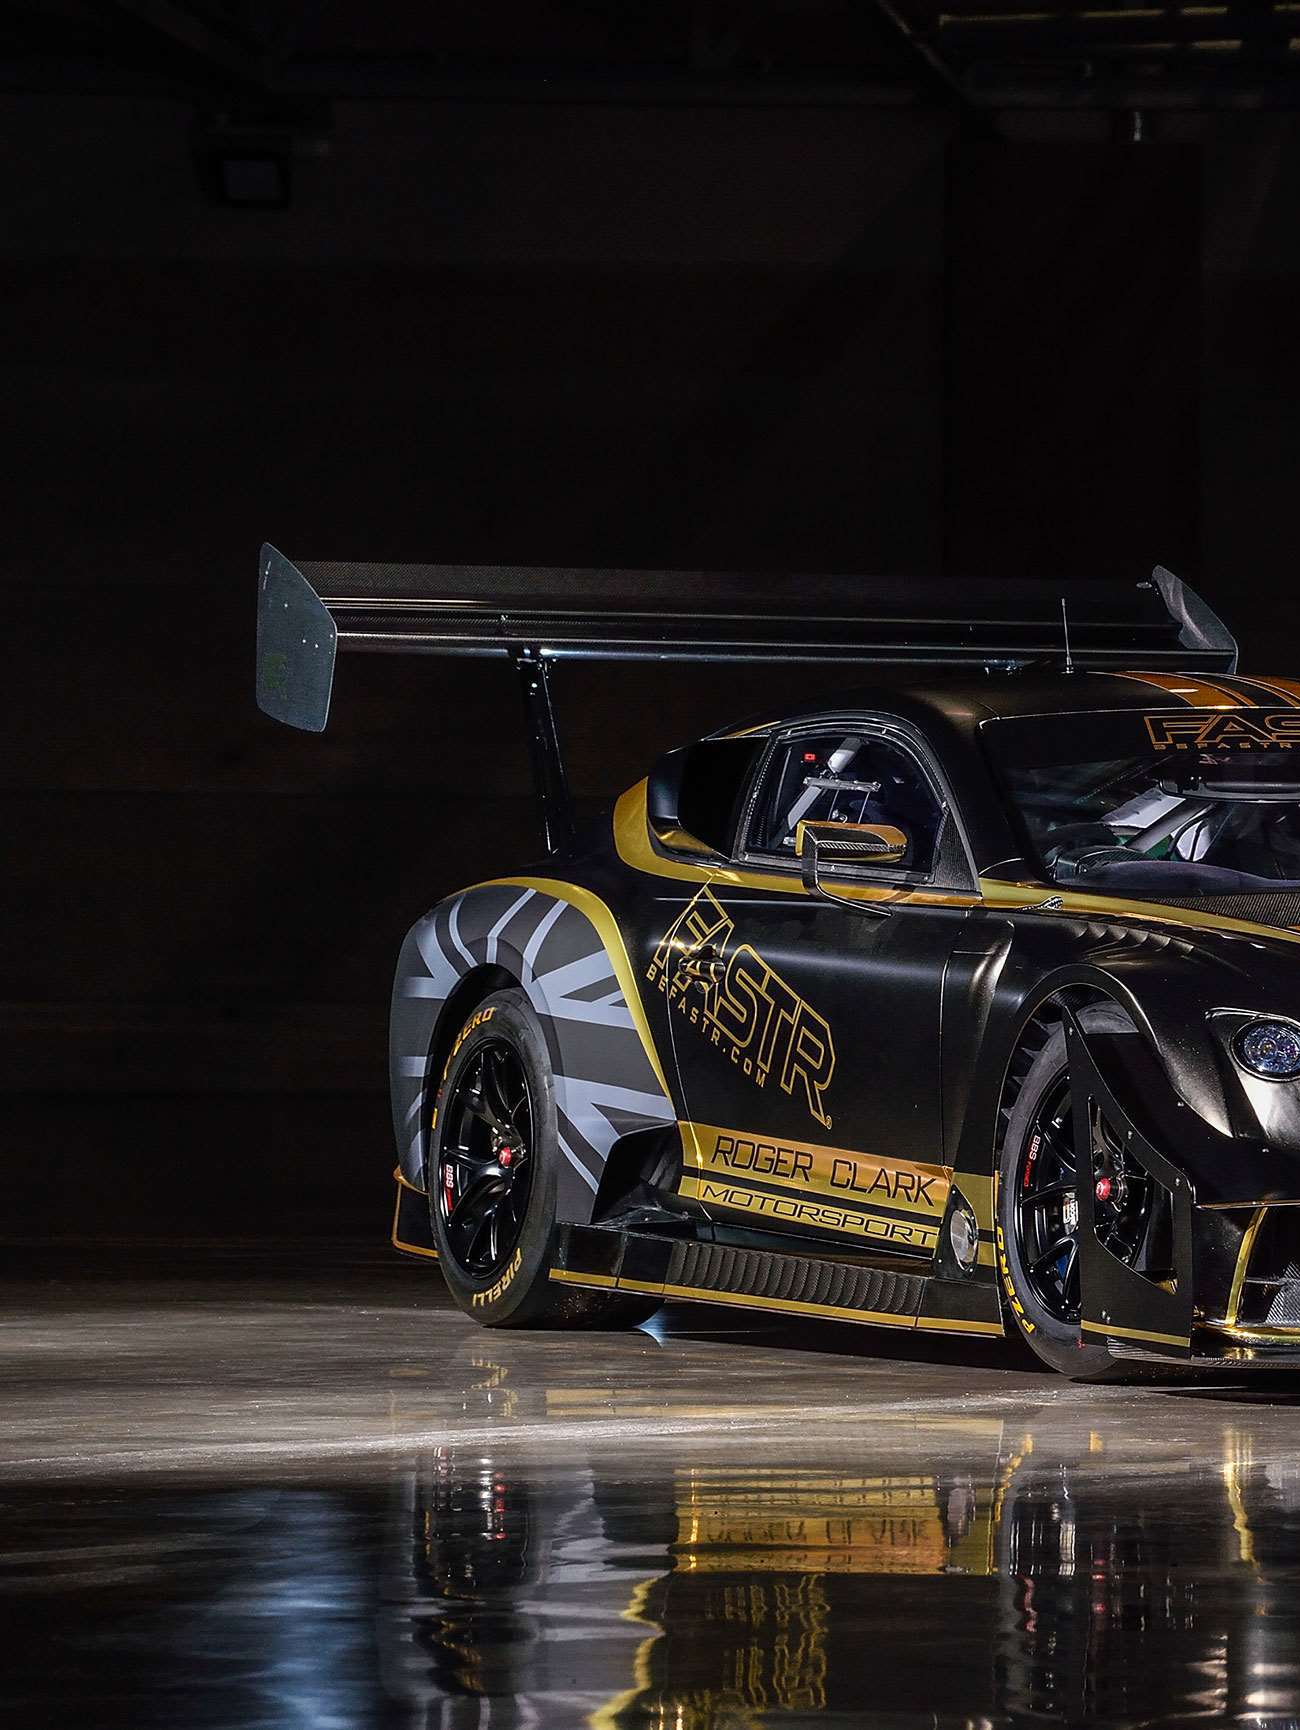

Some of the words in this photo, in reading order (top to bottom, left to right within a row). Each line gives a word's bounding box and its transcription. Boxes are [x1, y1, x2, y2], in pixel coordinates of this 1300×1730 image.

[646, 963, 767, 1088] BEFASTR.COM
[711, 1135, 814, 1182] ROGER
[829, 1159, 936, 1207] CLARK
[702, 1185, 937, 1245] MOTORSPORT
[472, 1247, 523, 1307] PIRELLI
